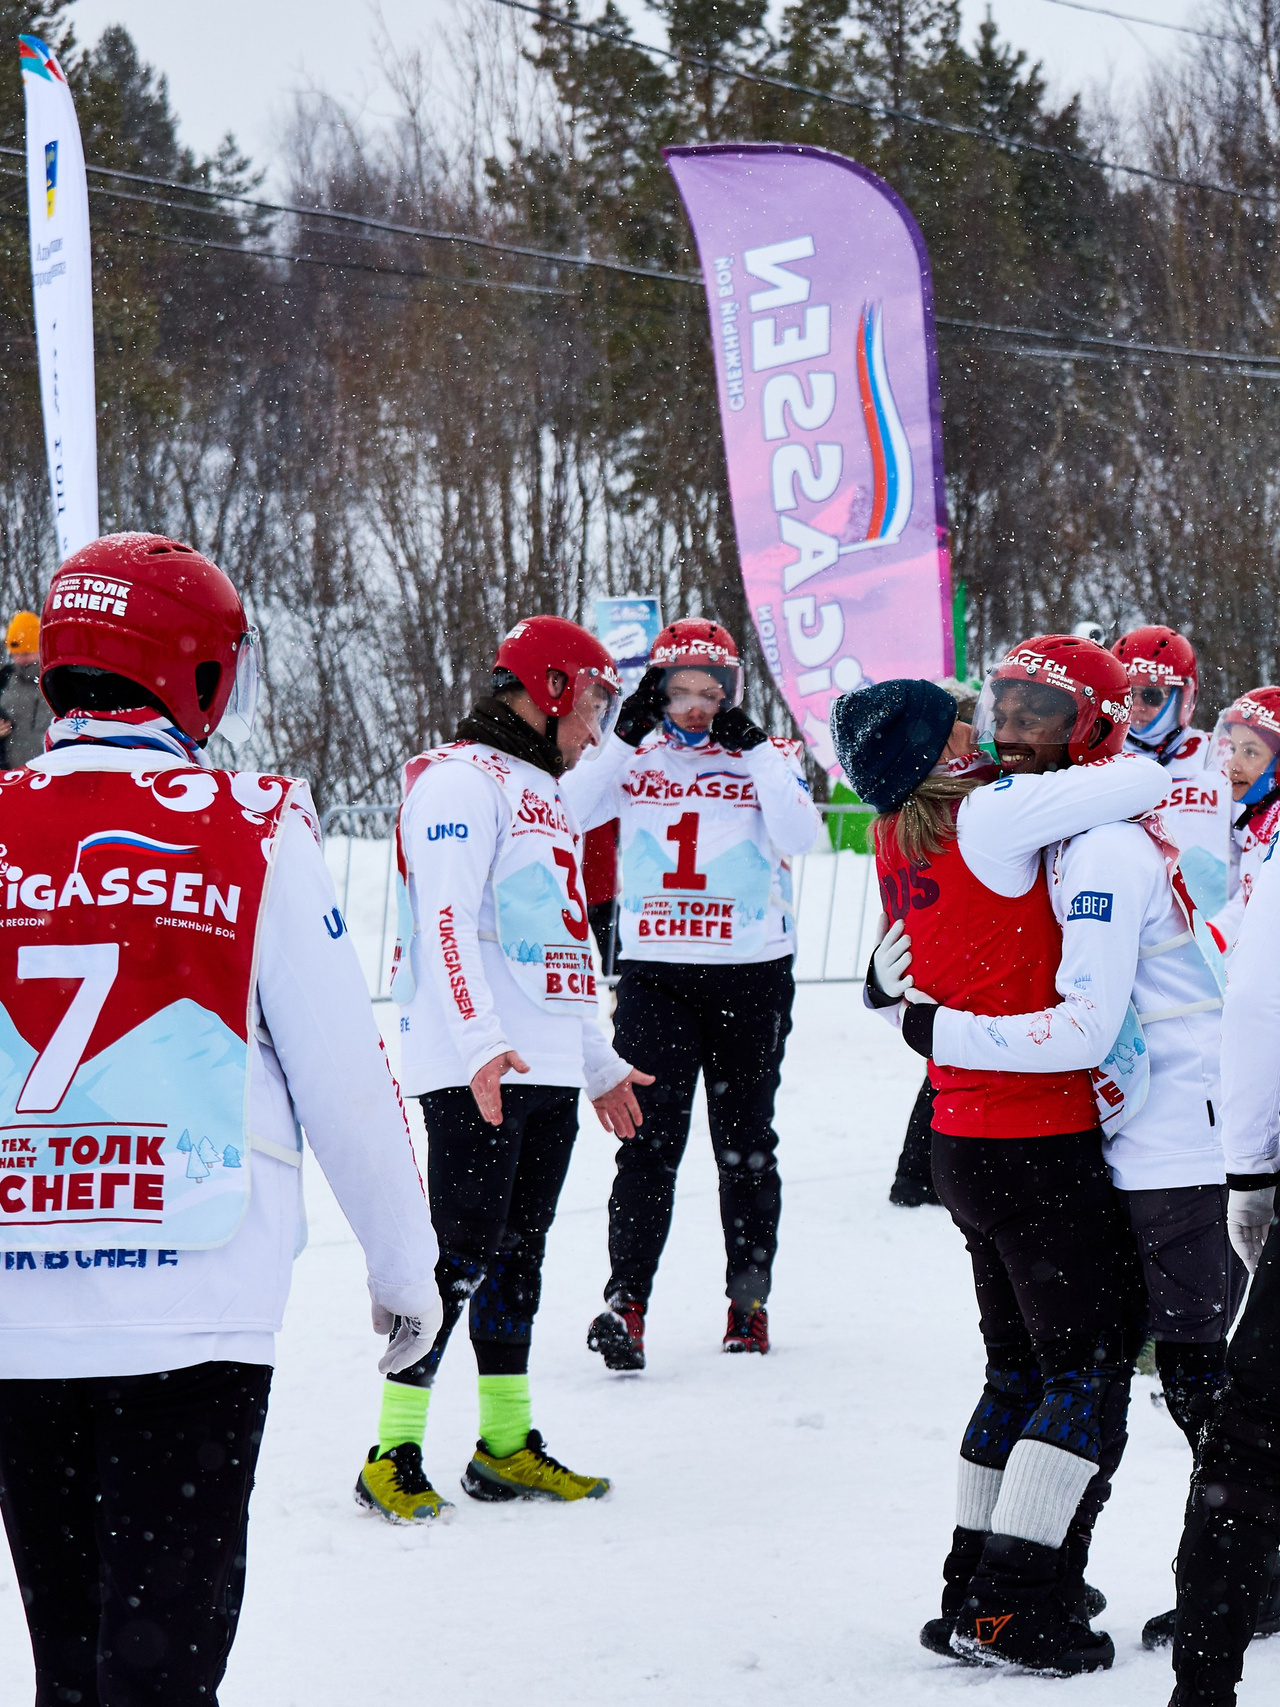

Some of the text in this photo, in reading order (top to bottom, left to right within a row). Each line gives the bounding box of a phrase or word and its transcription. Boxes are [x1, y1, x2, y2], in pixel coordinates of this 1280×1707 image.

[83, 578, 131, 600] ТОЛК
[52, 592, 128, 617] В СНЕГЕ
[427, 822, 469, 841] UNO
[662, 811, 707, 891] 1
[552, 847, 589, 942] 3
[677, 901, 734, 918] ТОЛК
[6, 917, 45, 927] REGION
[155, 916, 236, 940] СНЕЖНЫЙ БОЙ
[638, 919, 732, 939] В СНЕГЕ
[439, 904, 477, 1021] YUKIGASSEN
[545, 951, 579, 962] ДЛЯ ТЕХ,
[546, 973, 563, 995] В
[17, 942, 120, 1114] 7
[0, 1138, 37, 1153] ТЕХ,
[48, 1135, 166, 1167] ТОЛК
[0, 1172, 165, 1214] СНЕГЕ
